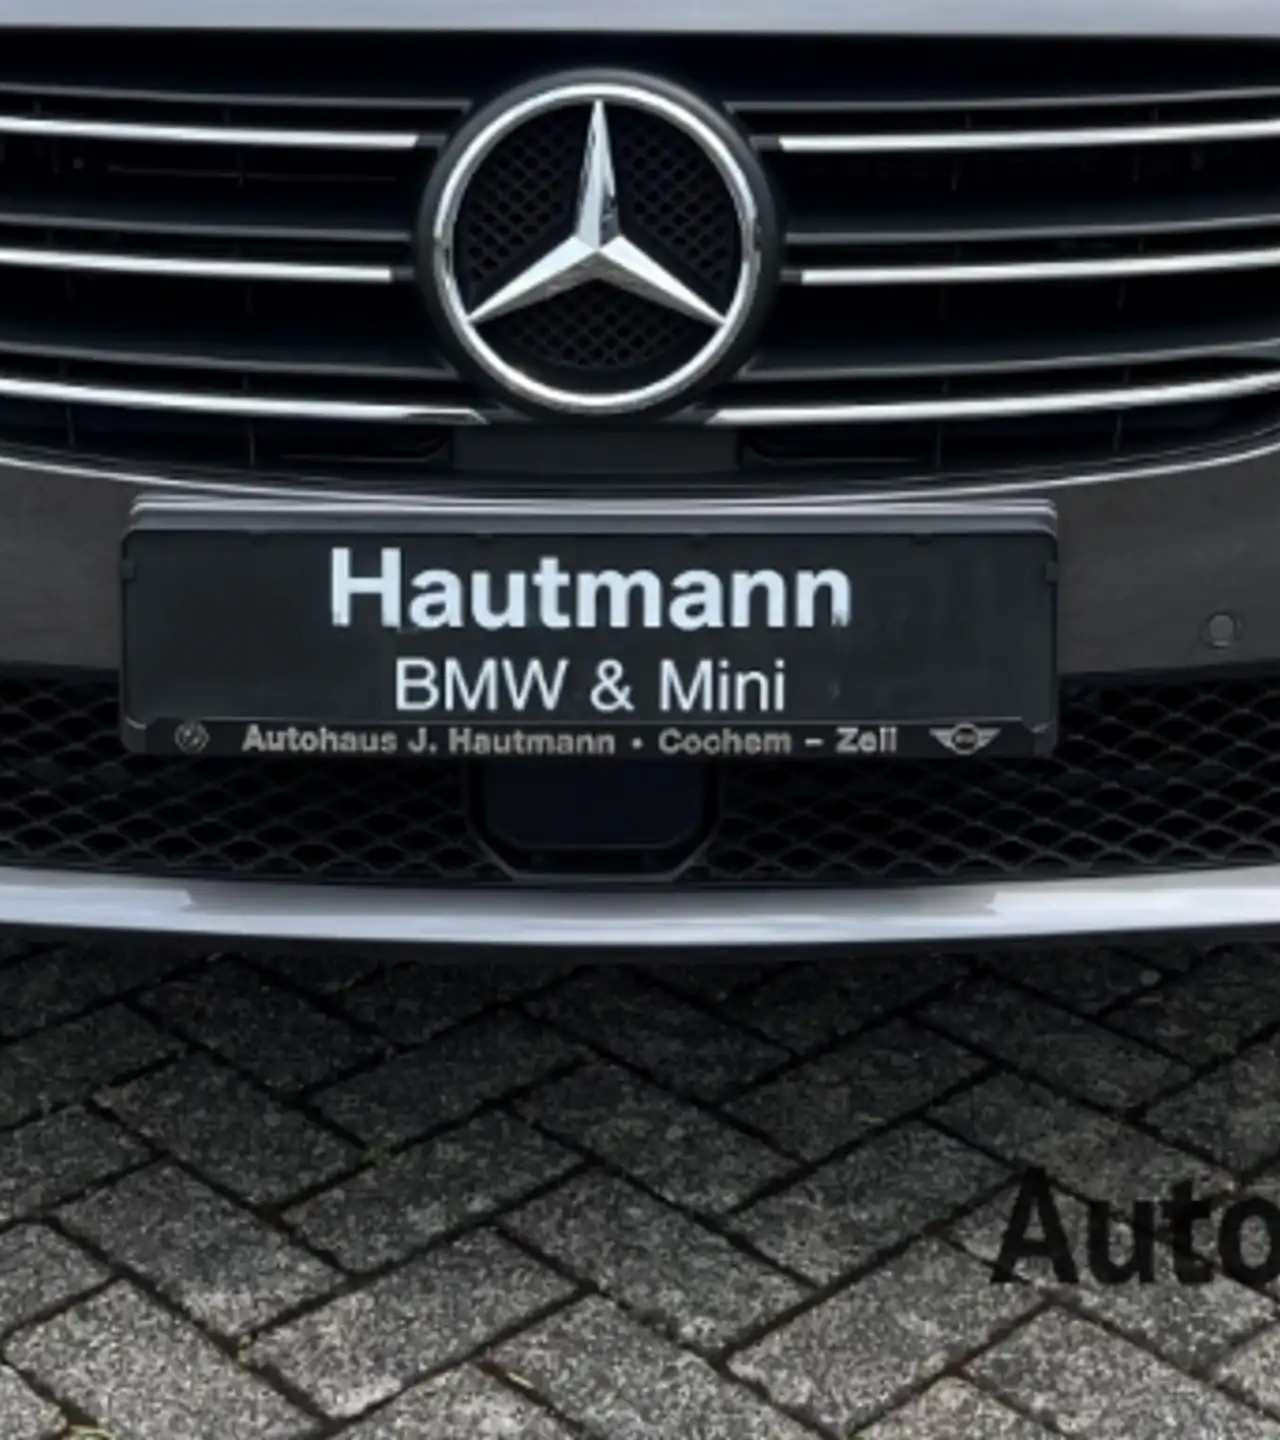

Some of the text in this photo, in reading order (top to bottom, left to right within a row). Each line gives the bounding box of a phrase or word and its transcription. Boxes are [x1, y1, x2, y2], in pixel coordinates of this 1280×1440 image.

[329, 546, 853, 631] Hautmann
[395, 657, 787, 712] BMW & Mini
[242, 724, 398, 753] Autohaus
[408, 727, 438, 754] J.
[448, 728, 616, 755] Hautmann
[657, 728, 792, 754] Cochem
